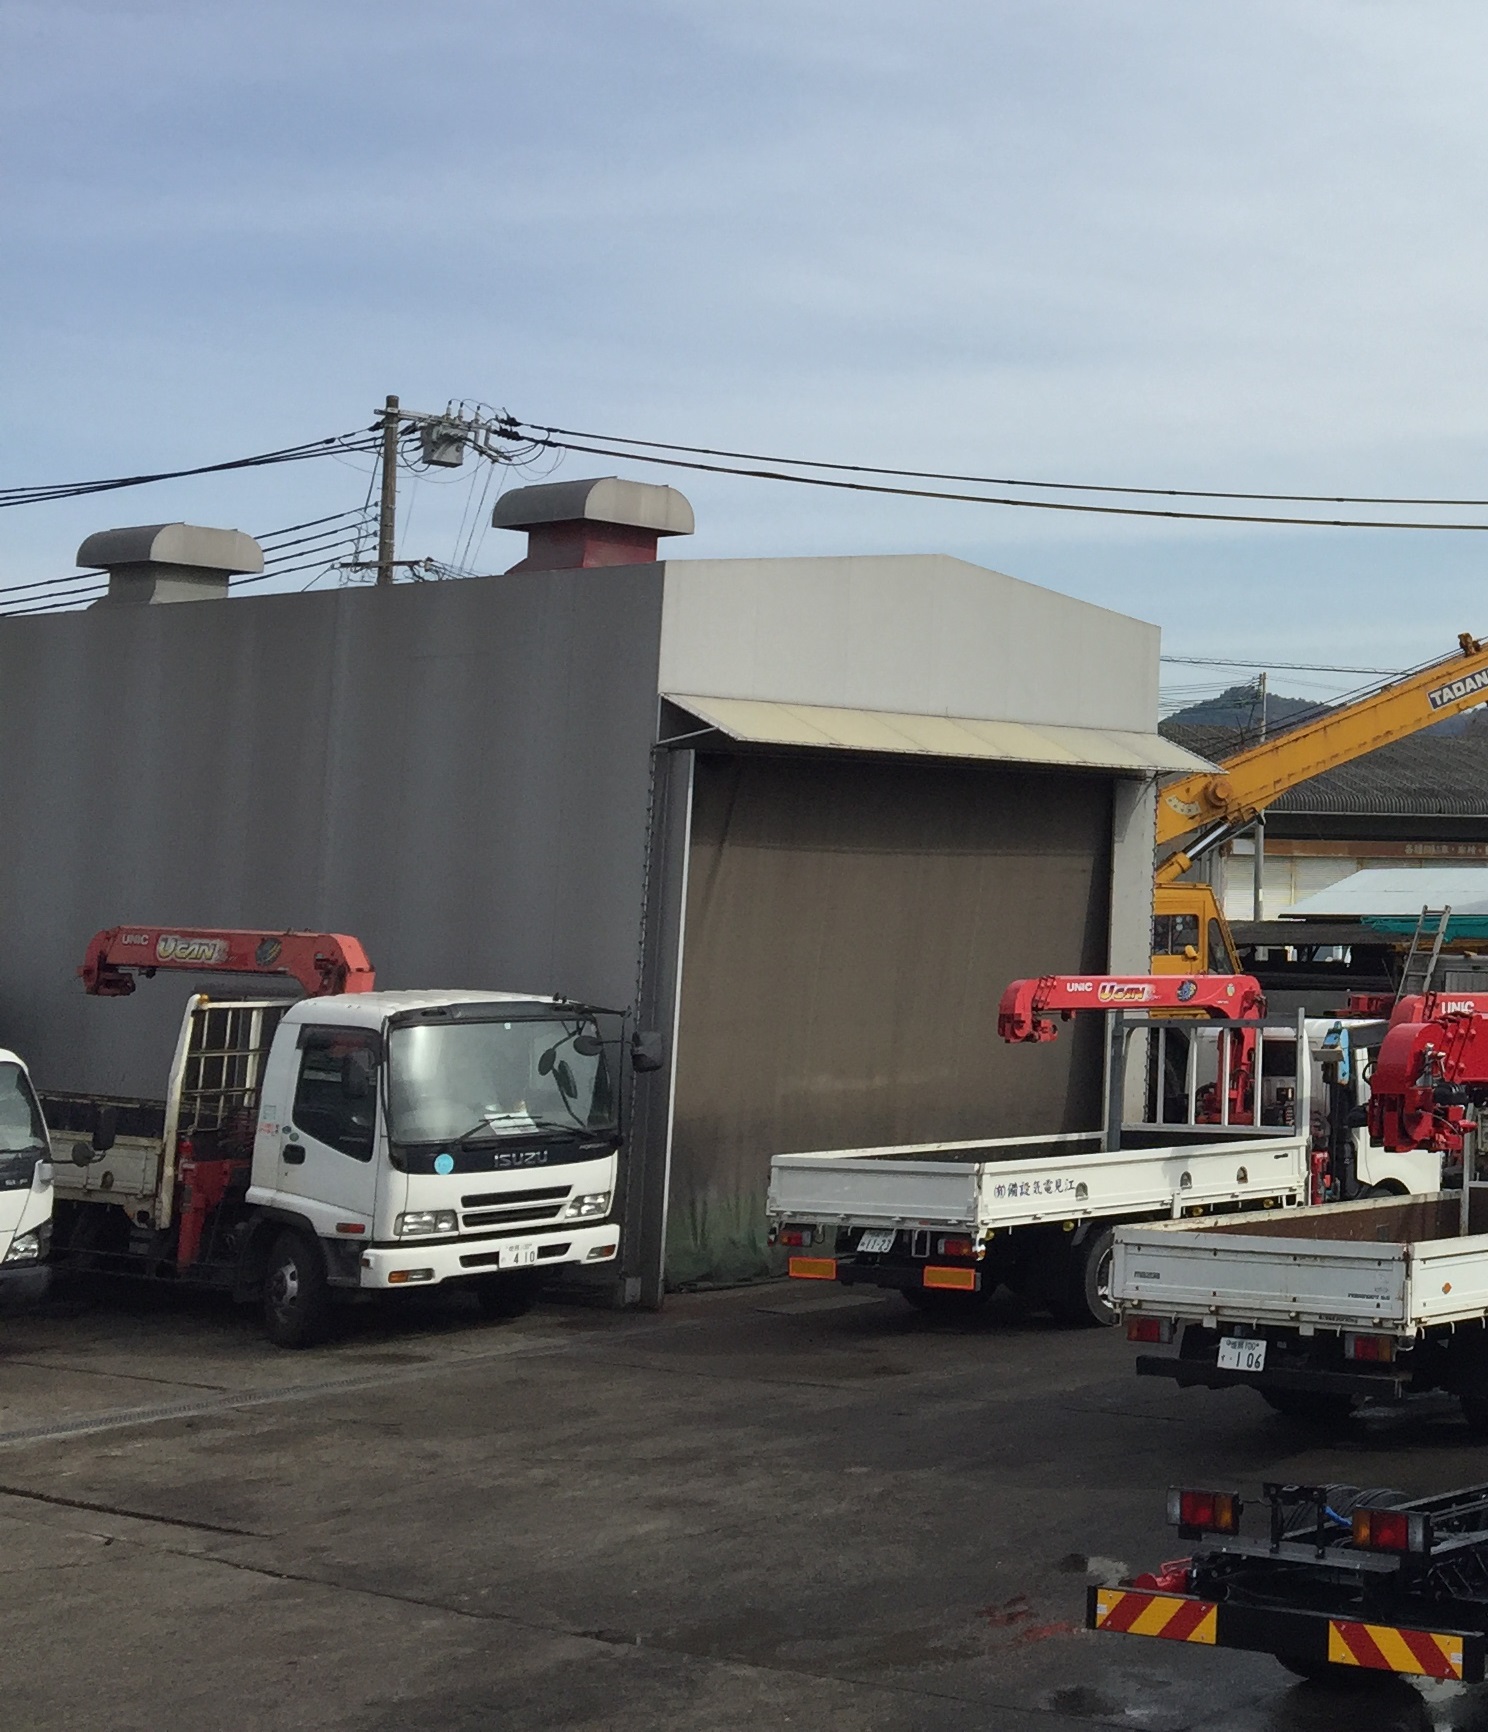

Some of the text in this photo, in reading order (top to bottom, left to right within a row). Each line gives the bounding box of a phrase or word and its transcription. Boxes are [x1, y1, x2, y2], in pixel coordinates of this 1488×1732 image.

[122, 934, 149, 946] UNIC
[1066, 982, 1093, 992] UNIC
[1441, 1001, 1475, 1015] UNIC
[494, 1150, 548, 1168] ISUZU
